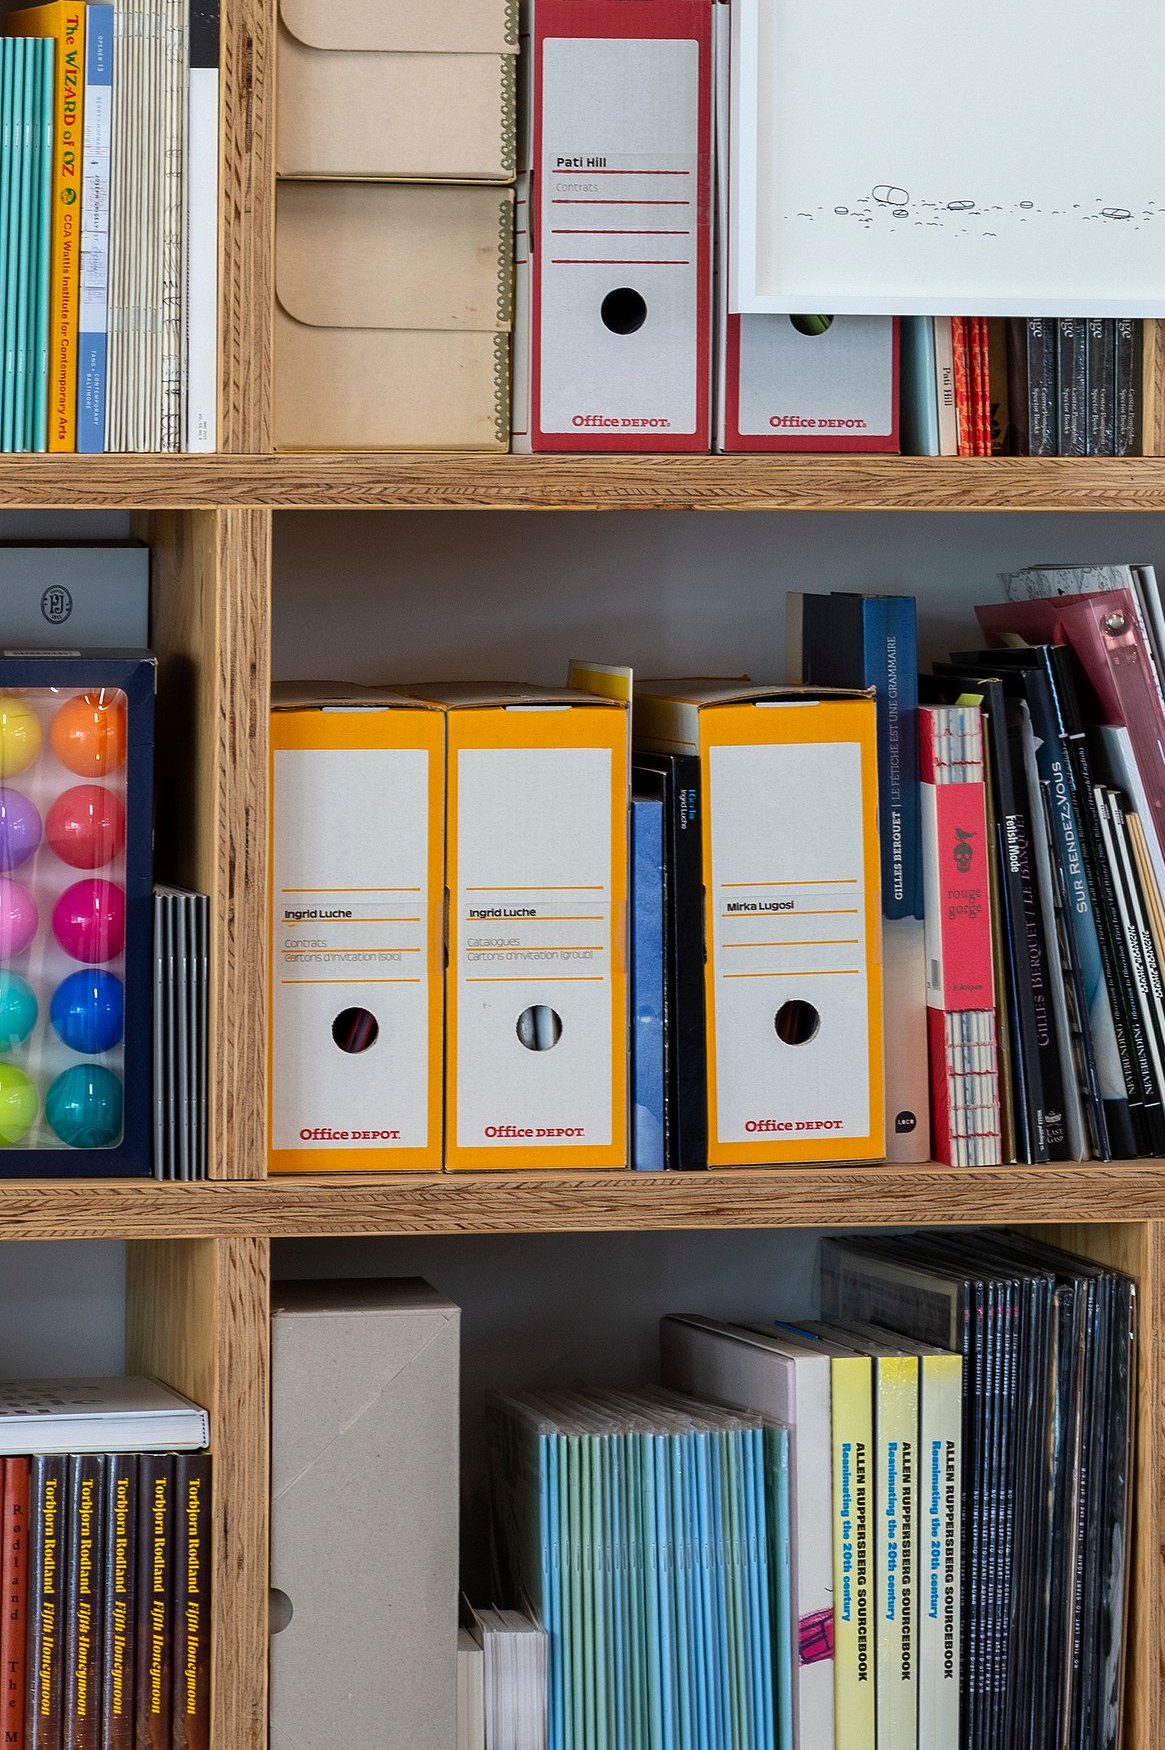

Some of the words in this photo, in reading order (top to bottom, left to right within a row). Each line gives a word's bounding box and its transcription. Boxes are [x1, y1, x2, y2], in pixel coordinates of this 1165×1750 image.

[64, 15, 79, 46] The
[63, 50, 79, 126] WIZARD
[63, 129, 74, 148] of
[61, 150, 77, 179] OZ
[556, 156, 584, 168] Pati
[586, 156, 608, 168] Hill
[572, 414, 620, 428] Office
[621, 417, 672, 428] DEPOT
[1052, 760, 1082, 875] RENDEZ-VOUS
[892, 810, 902, 863] BERQUET
[893, 864, 905, 901] GILLES
[1074, 879, 1088, 915] SUR
[284, 908, 317, 920] Ingrid
[319, 908, 353, 918] Luche
[726, 901, 756, 912] Mirka
[758, 900, 795, 912] Lugosi
[300, 1128, 349, 1141] Office
[350, 1130, 401, 1140] DEPOT
[841, 1443, 851, 1518] Reanimating
[856, 1442, 867, 1486] ALLEN
[842, 1520, 851, 1540] the
[856, 1487, 867, 1589] RUPPERSBERG
[187, 1538, 201, 1594] Rødland
[842, 1541, 852, 1572] 20th
[186, 1600, 200, 1632] Fifth
[841, 1573, 852, 1623] century
[858, 1590, 869, 1683] SOURCEBOOK
[185, 1633, 199, 1716] Honeymoon
